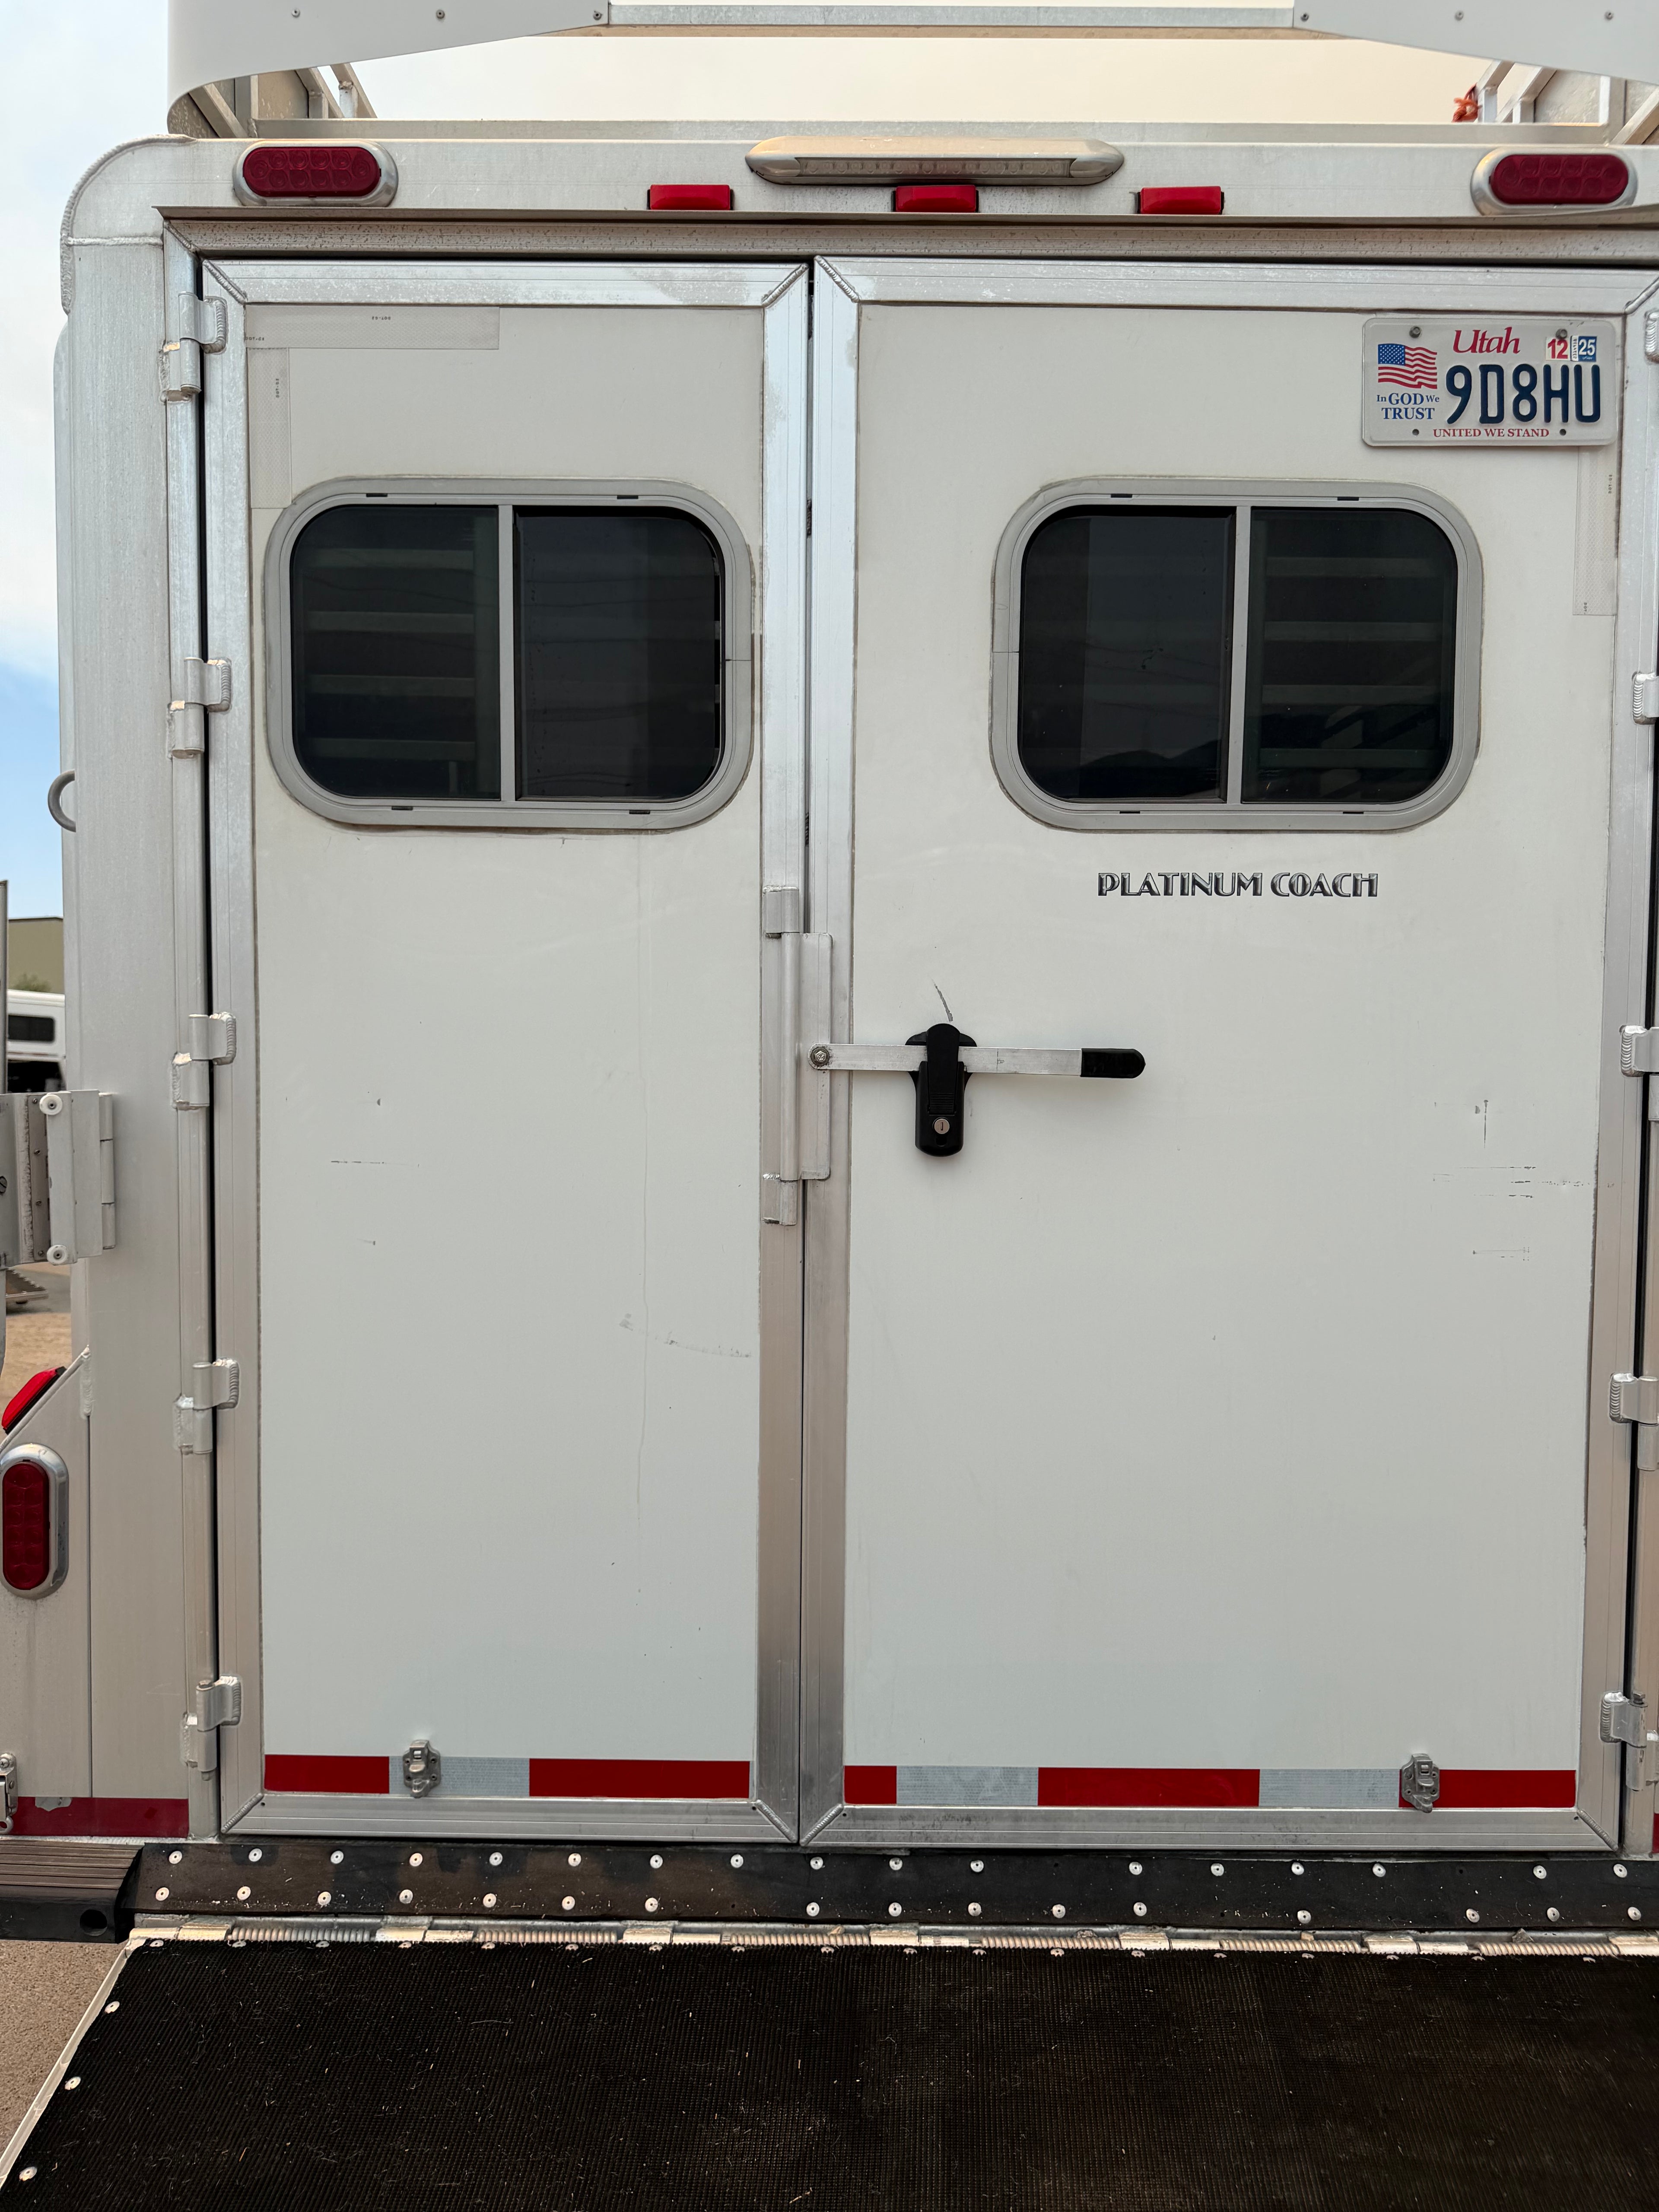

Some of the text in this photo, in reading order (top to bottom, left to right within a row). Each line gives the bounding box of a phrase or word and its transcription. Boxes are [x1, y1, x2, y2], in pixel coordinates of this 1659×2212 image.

[1452, 327, 1521, 354] Utah
[1548, 338, 1568, 359] 12
[1578, 339, 1595, 356] 25
[1388, 393, 1424, 405] GOD
[1445, 363, 1601, 425] 9D8HU
[1381, 407, 1435, 420] TRUST
[1433, 428, 1550, 437] UNITED WE STAND
[1098, 873, 1378, 896] PLATINUM COACH
